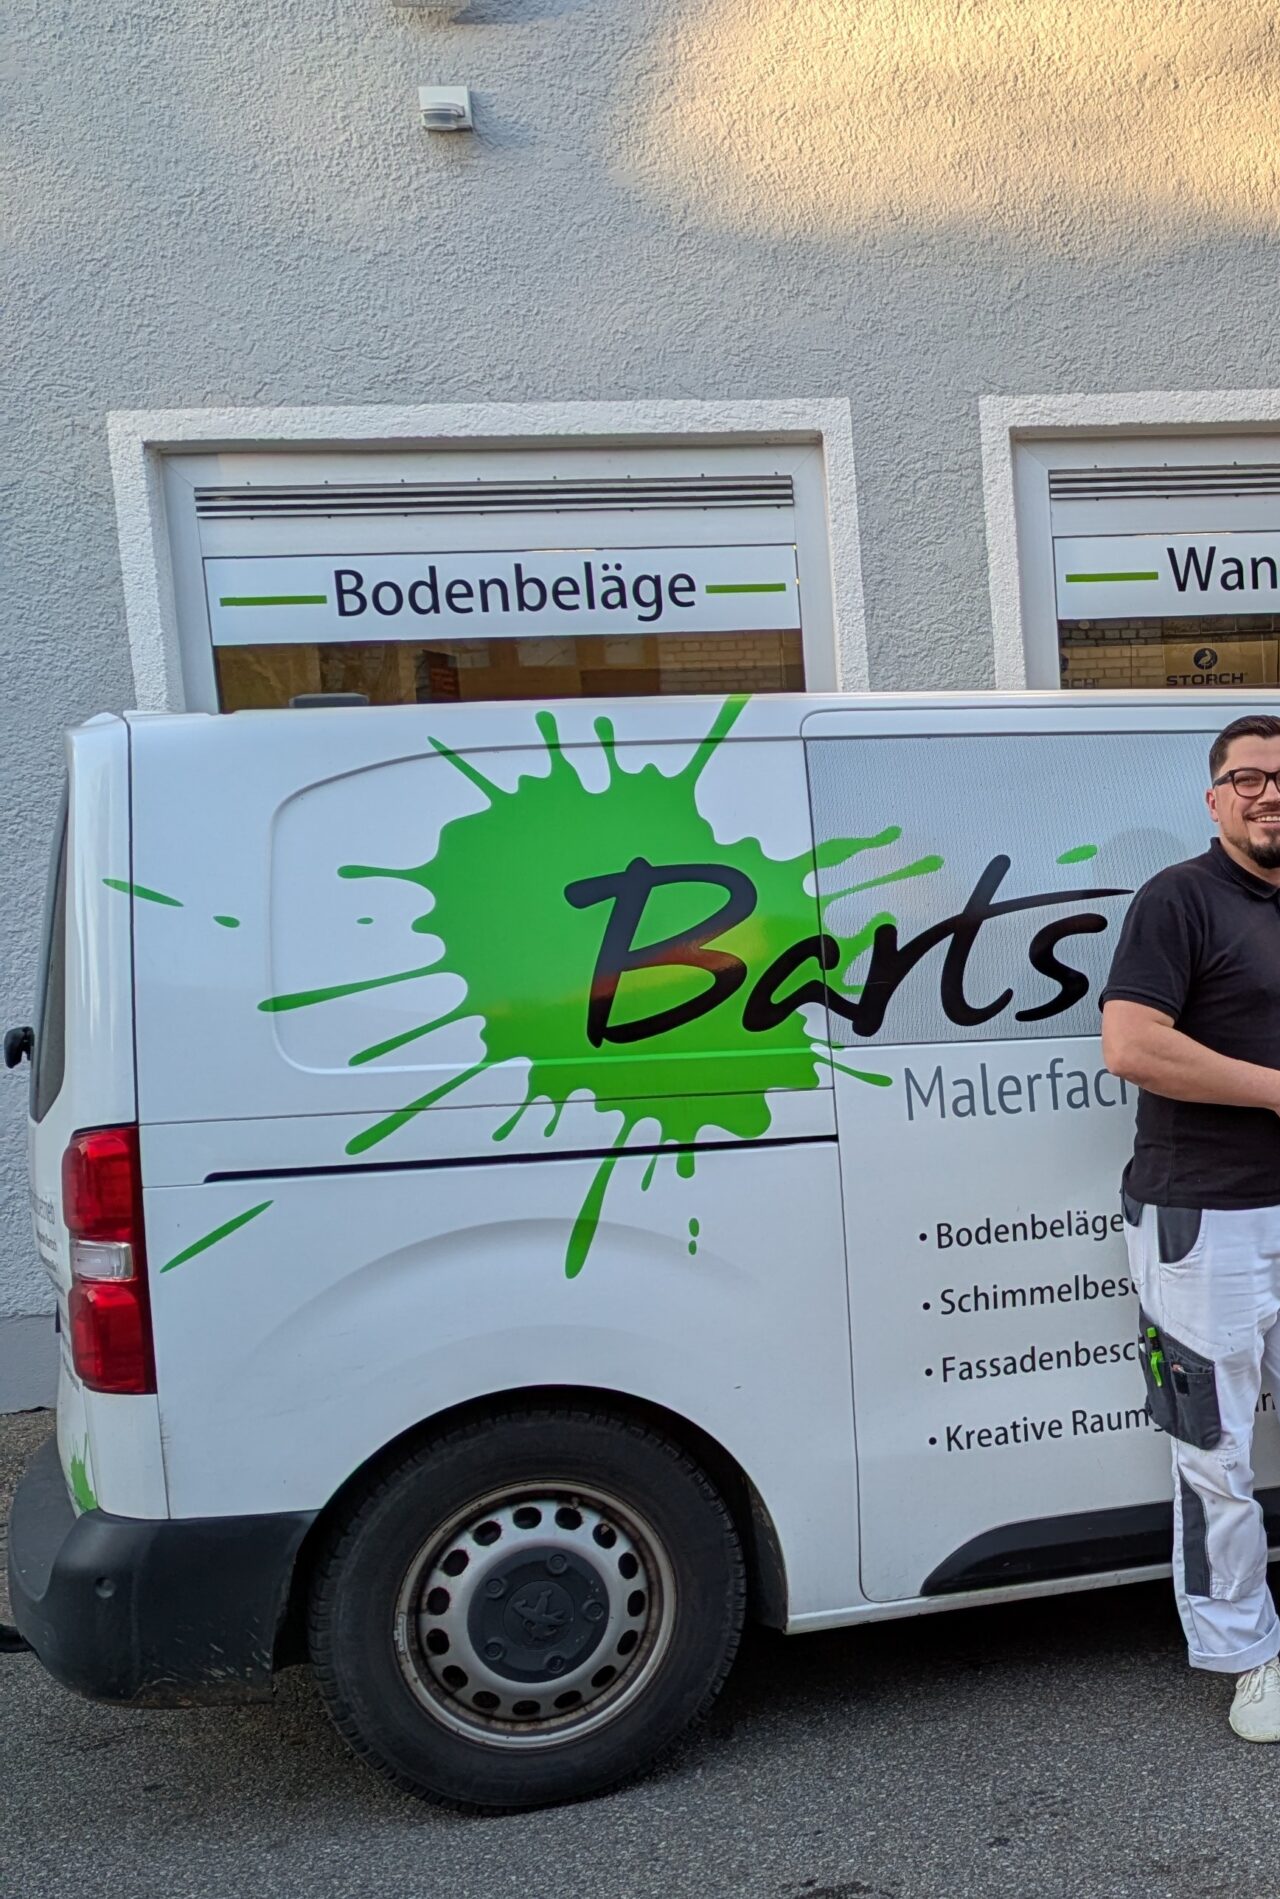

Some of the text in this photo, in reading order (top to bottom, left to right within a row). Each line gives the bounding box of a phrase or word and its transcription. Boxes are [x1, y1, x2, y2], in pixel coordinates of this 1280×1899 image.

[333, 562, 697, 622] Bodenbeläge
[1166, 672, 1244, 687] STORCH
[564, 855, 1134, 1048] Barts
[936, 1209, 1124, 1249] Bodenbeläge
[942, 1341, 1141, 1382] Fassadenbesc
[945, 1406, 1162, 1452] Kreative Raum
